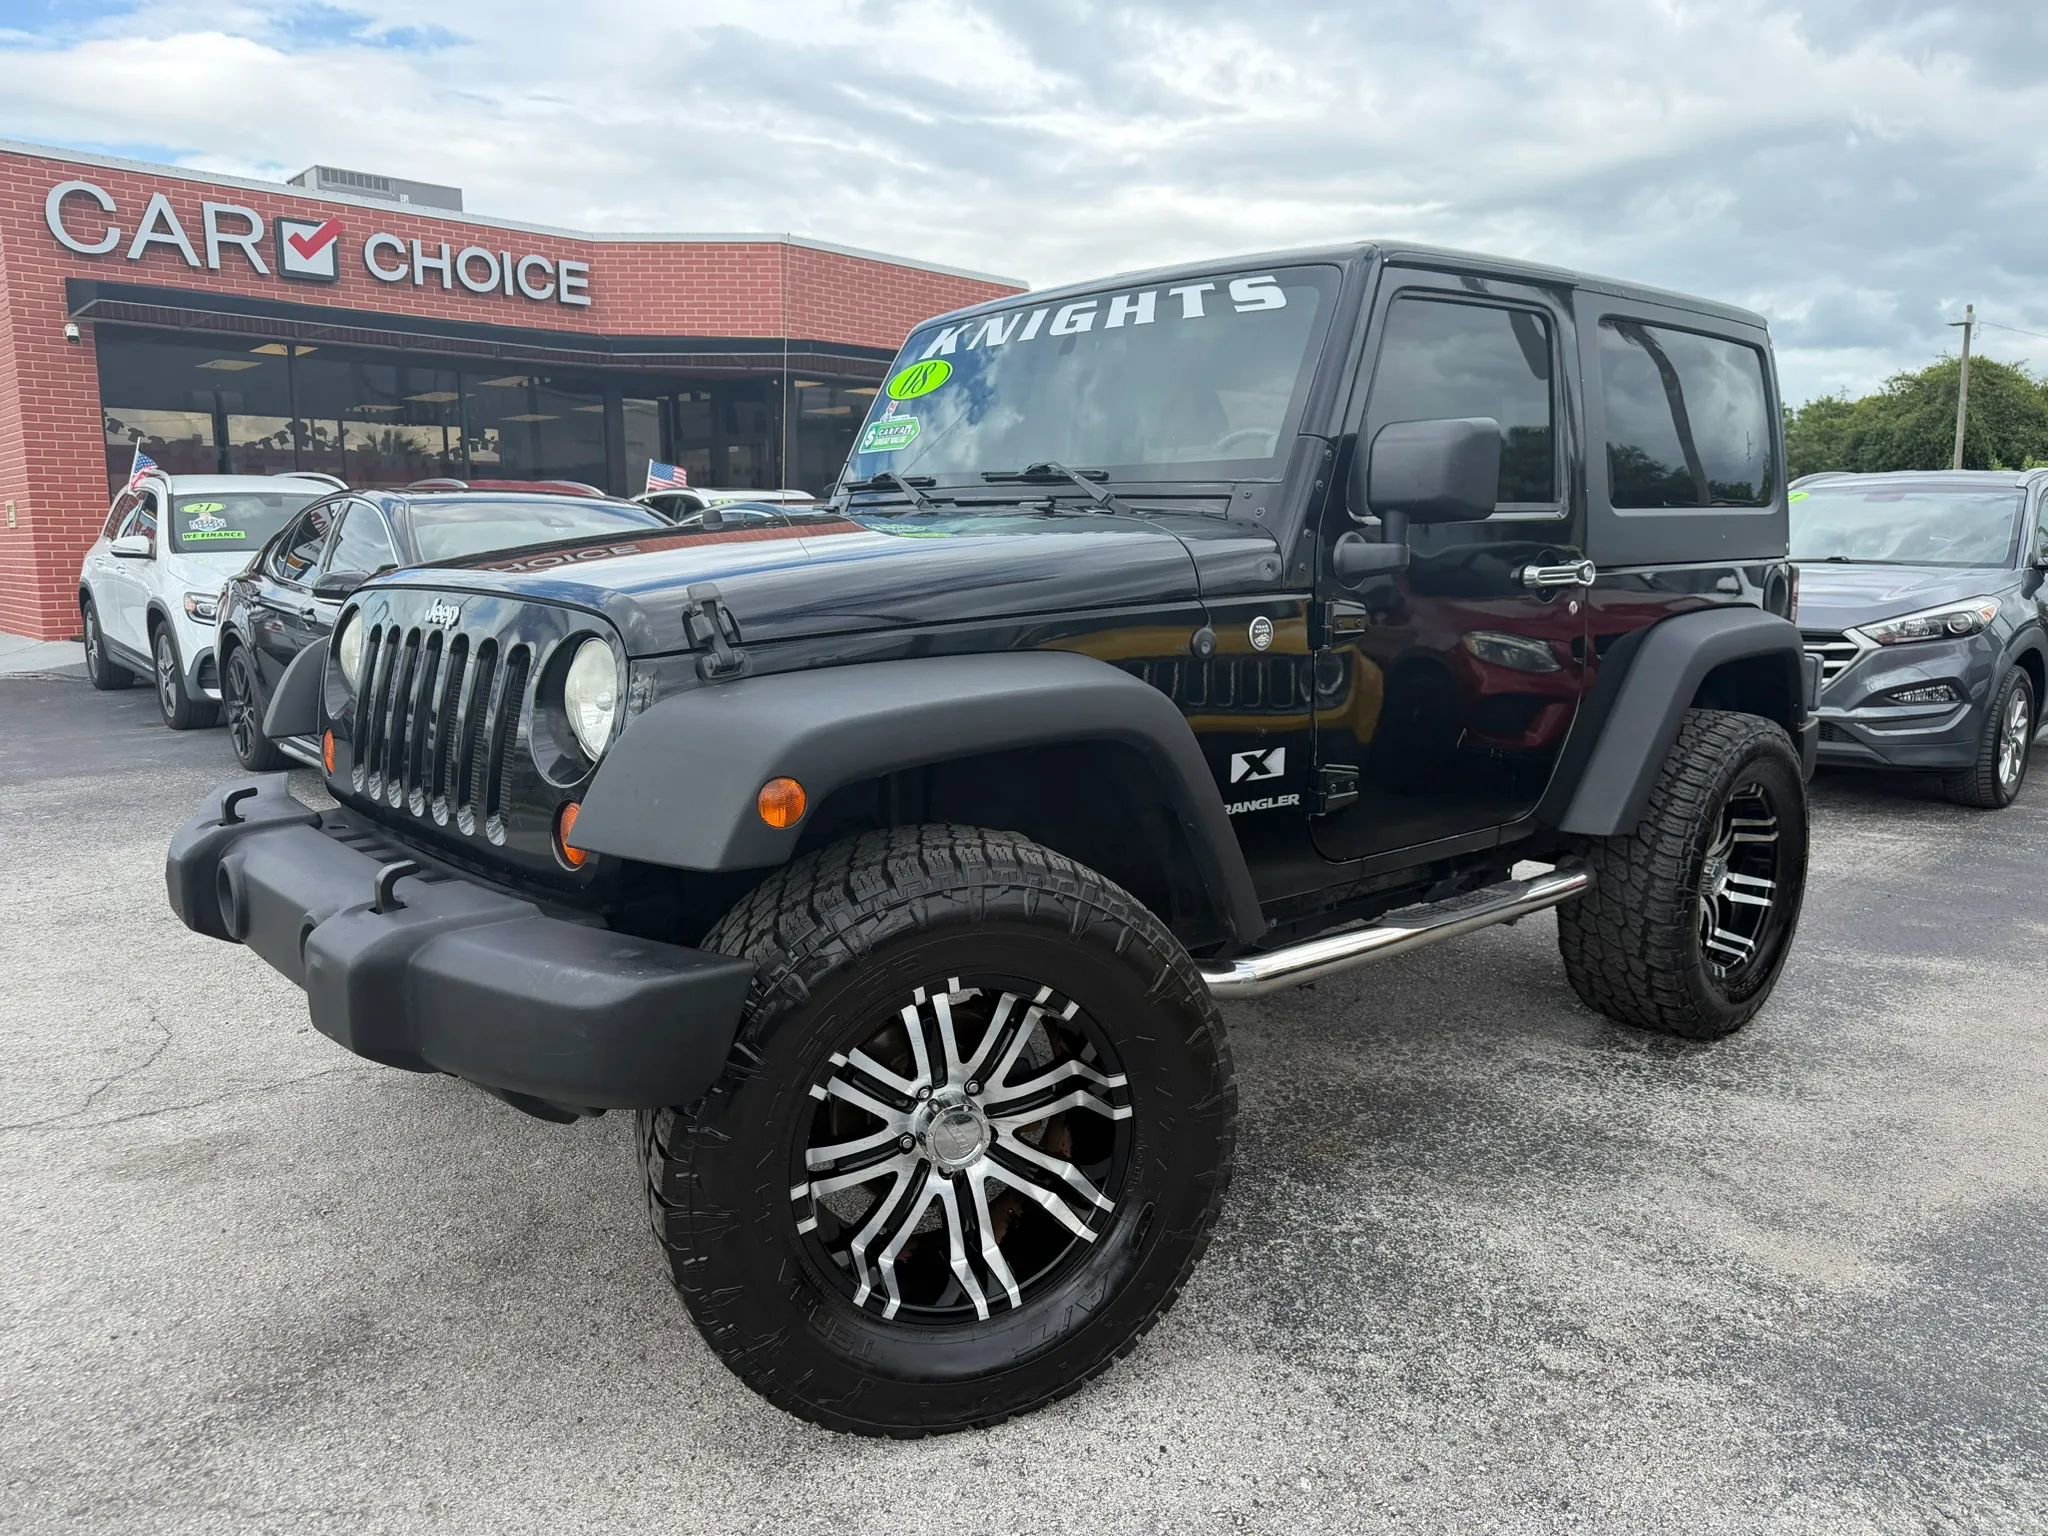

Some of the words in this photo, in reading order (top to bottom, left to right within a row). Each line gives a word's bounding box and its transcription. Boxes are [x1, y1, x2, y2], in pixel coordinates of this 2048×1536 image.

[45, 180, 271, 275] CAR
[363, 232, 592, 306] CHOICE
[918, 275, 1288, 360] KNIGHTS
[899, 362, 937, 396] 08
[424, 598, 461, 631] Jeep
[1235, 747, 1279, 783] X
[1224, 793, 1300, 815] RANGLER
